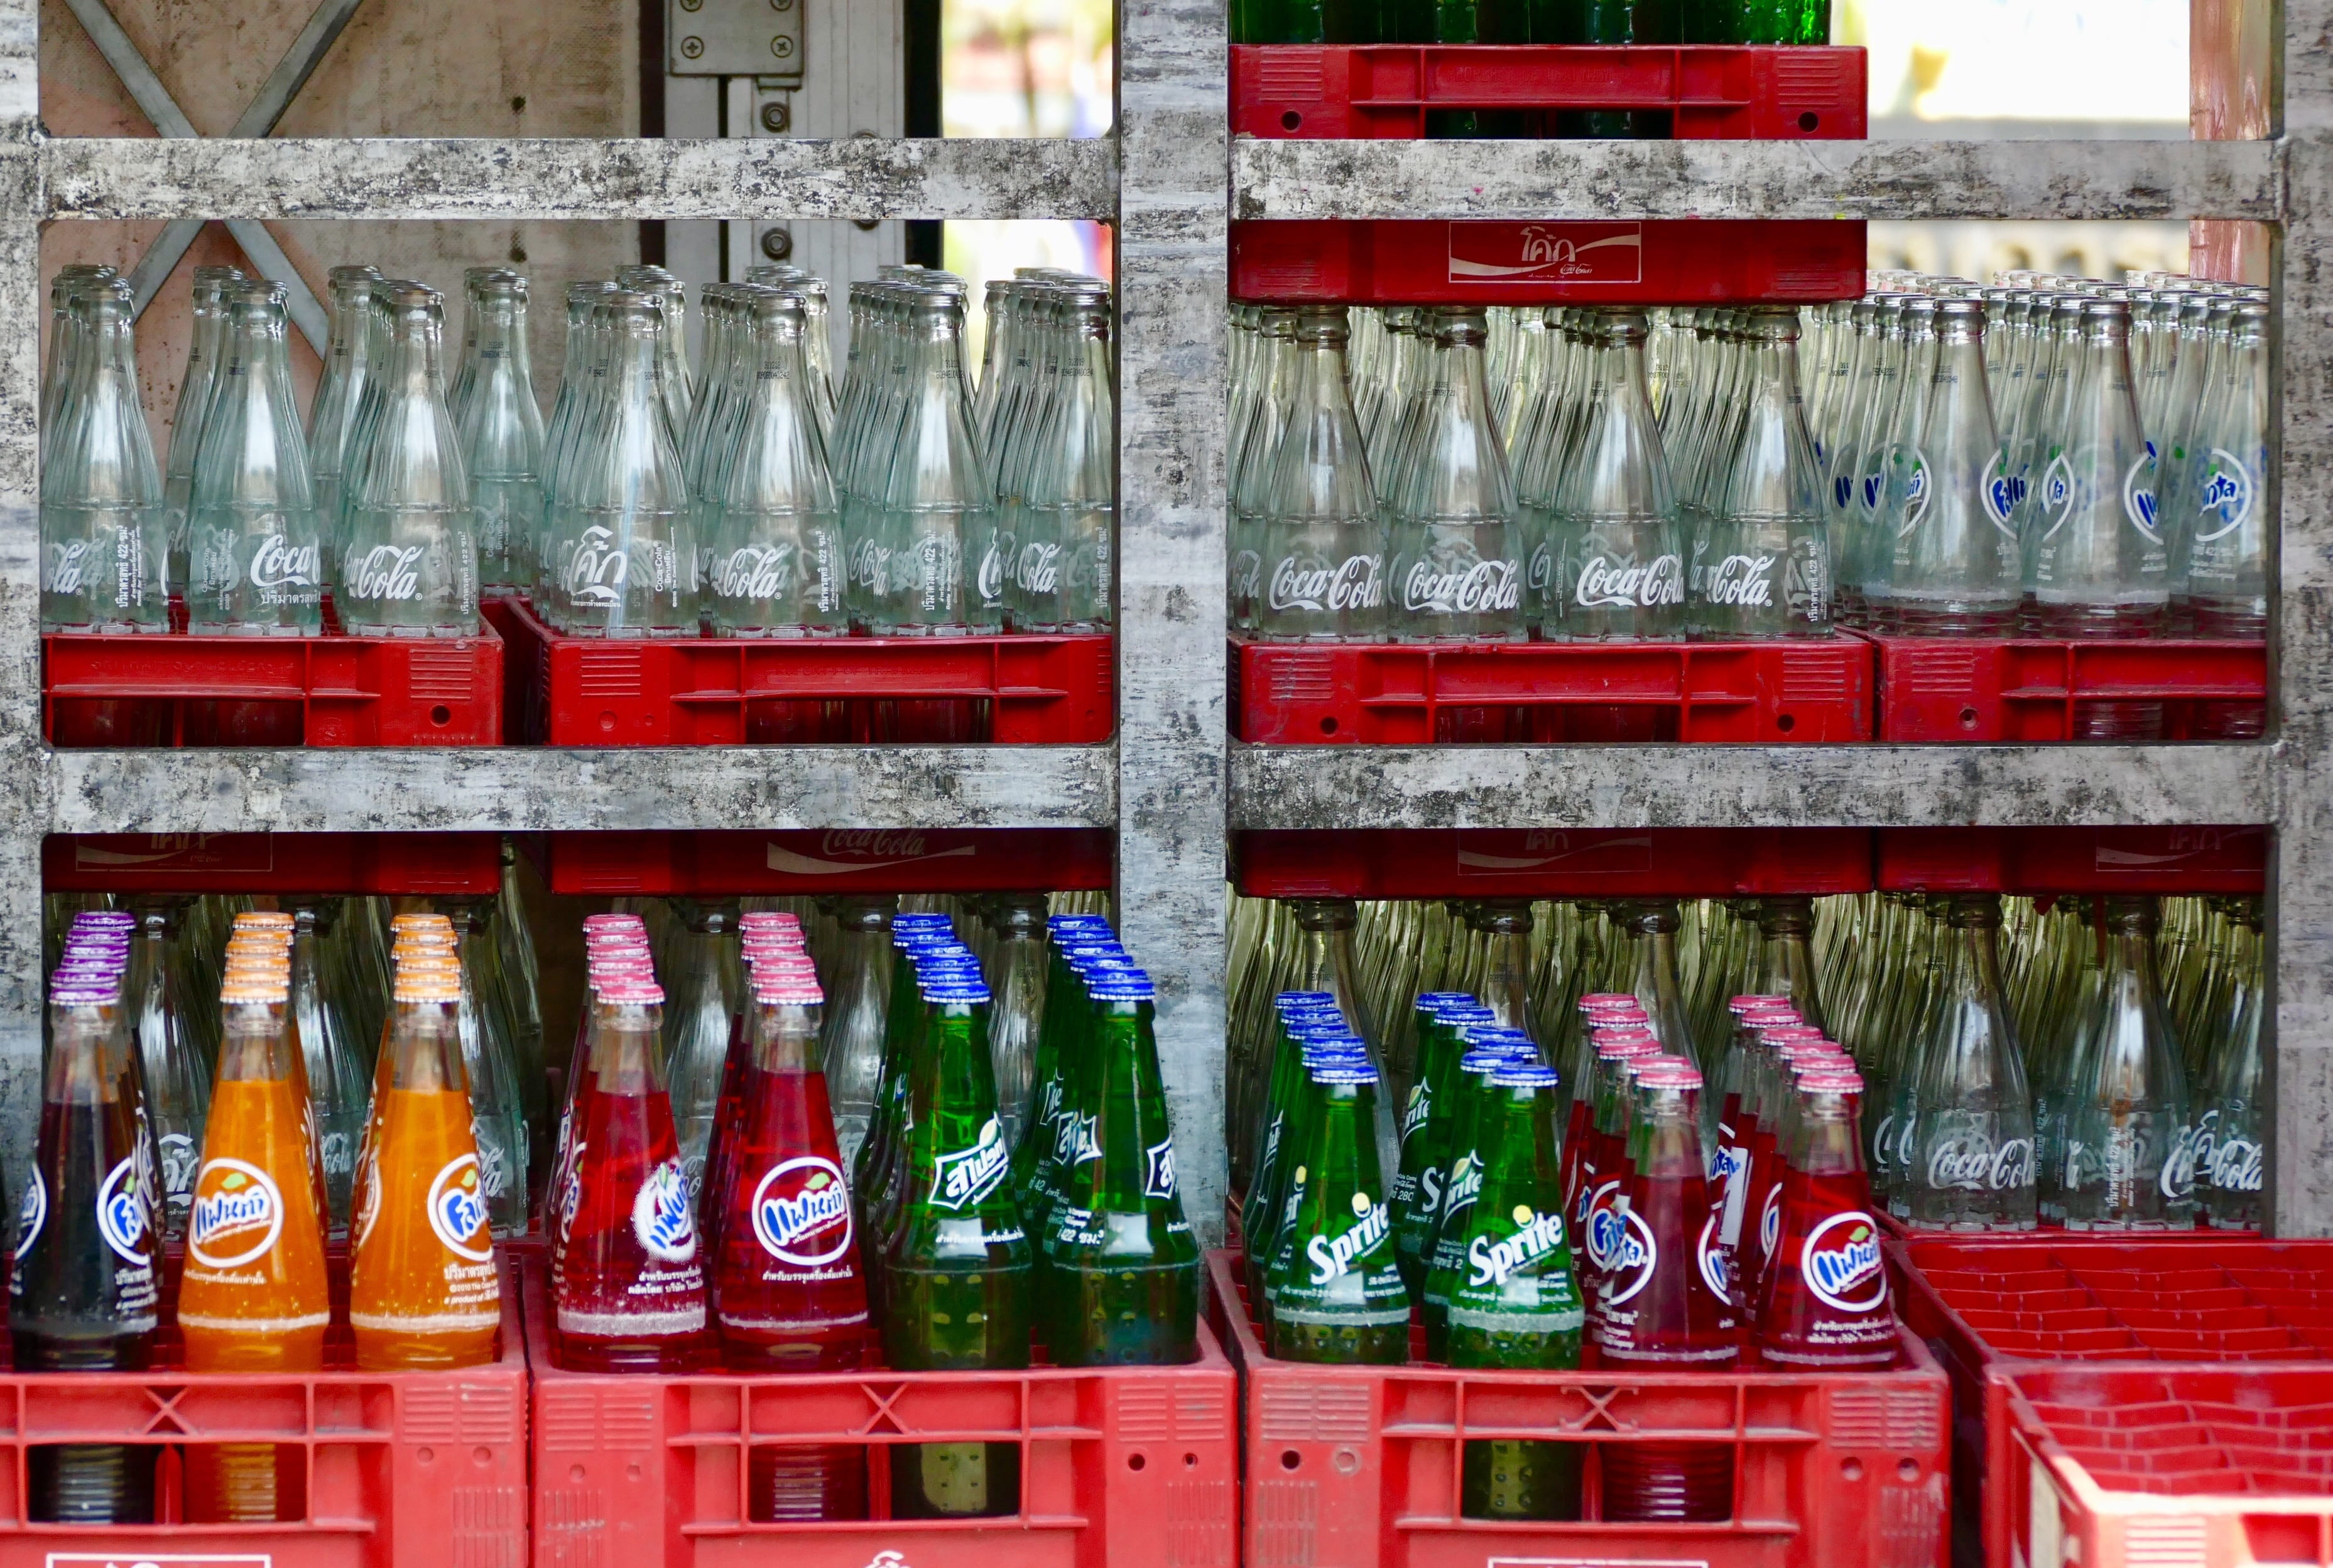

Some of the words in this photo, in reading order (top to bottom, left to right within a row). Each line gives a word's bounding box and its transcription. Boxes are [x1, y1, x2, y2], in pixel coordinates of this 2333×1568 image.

[117, 544, 128, 558] 422
[818, 549, 827, 564] 422
[924, 548, 935, 562] 422
[1097, 545, 1107, 559] 422
[1808, 559, 1817, 574] 422
[1269, 554, 1382, 611] Coca-Cola
[1405, 558, 1519, 612] Coca-Cola
[1577, 555, 1685, 607] Coca-Cola
[2109, 1145, 2120, 1160] 422
[1307, 1193, 1389, 1285] Sprite
[1469, 1205, 1563, 1286] Sprite
